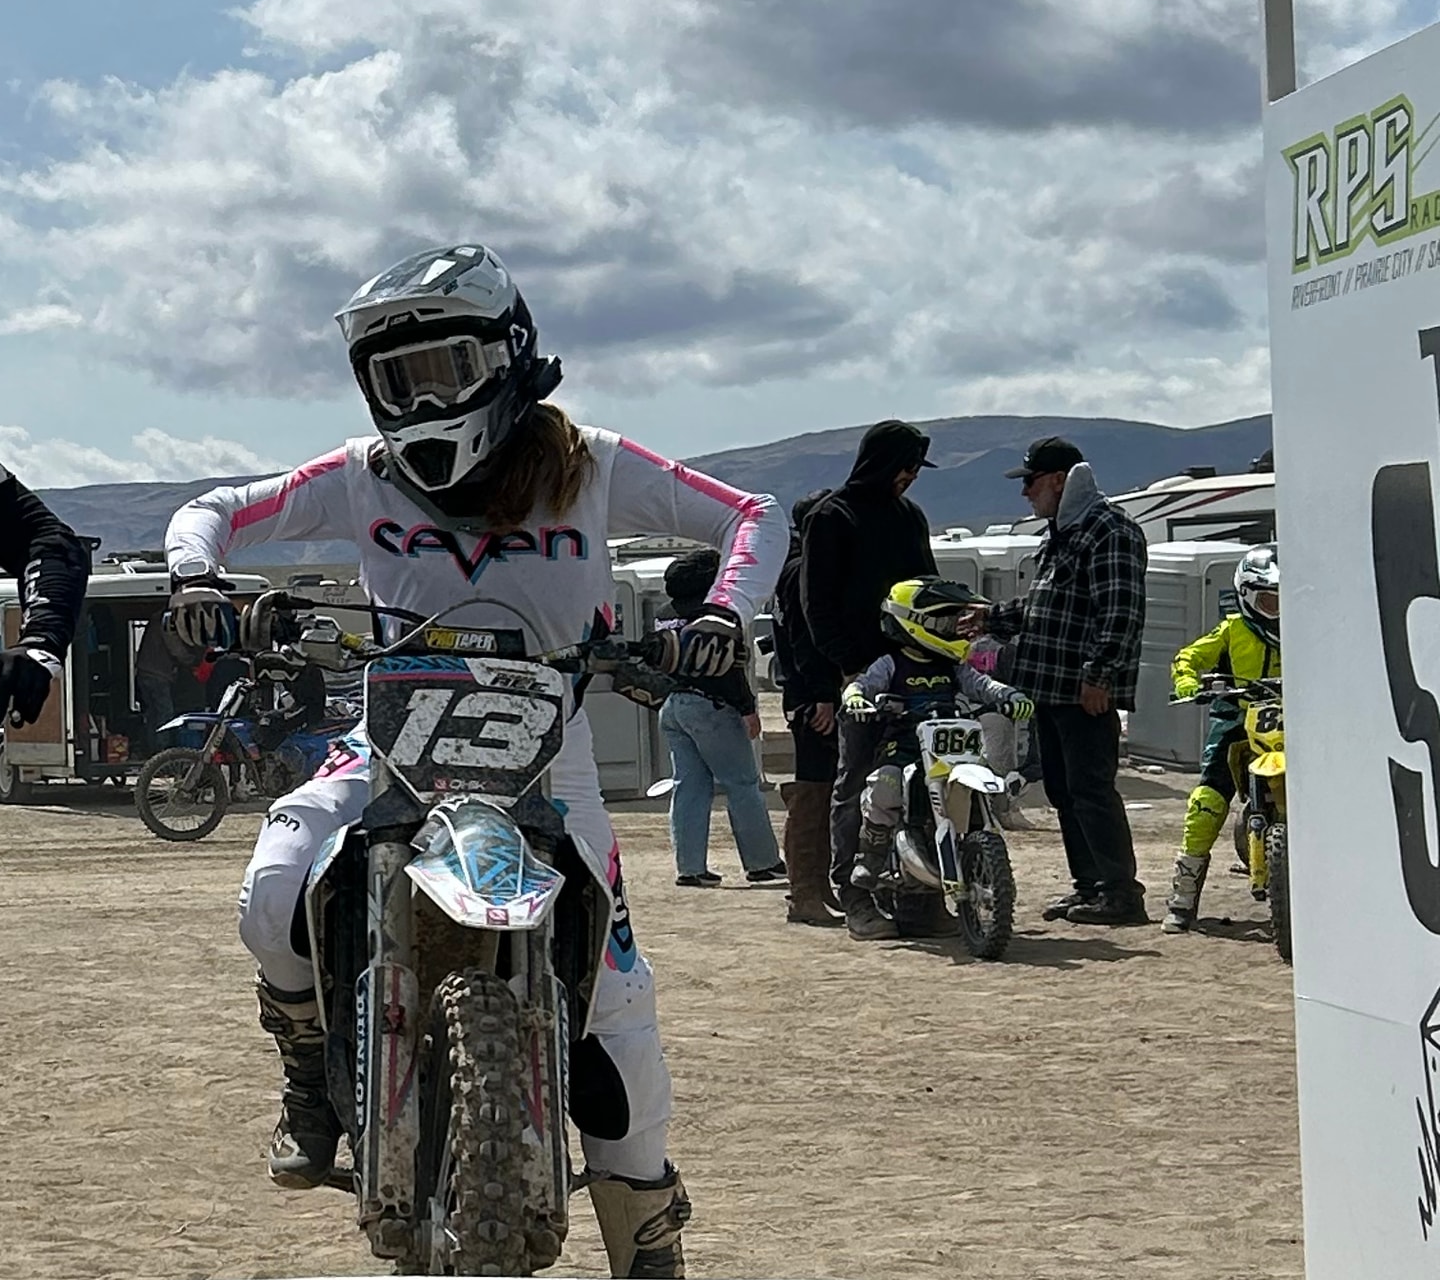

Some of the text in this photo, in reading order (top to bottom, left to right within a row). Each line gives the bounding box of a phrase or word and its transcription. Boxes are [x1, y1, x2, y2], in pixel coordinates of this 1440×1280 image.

[1290, 103, 1411, 266] RPS
[1392, 248, 1415, 280] CITY
[370, 518, 588, 586] seven
[428, 631, 495, 651] PROTAPER
[387, 688, 558, 770] 13
[932, 726, 984, 757] 864
[355, 991, 366, 1126] DUNLOP
